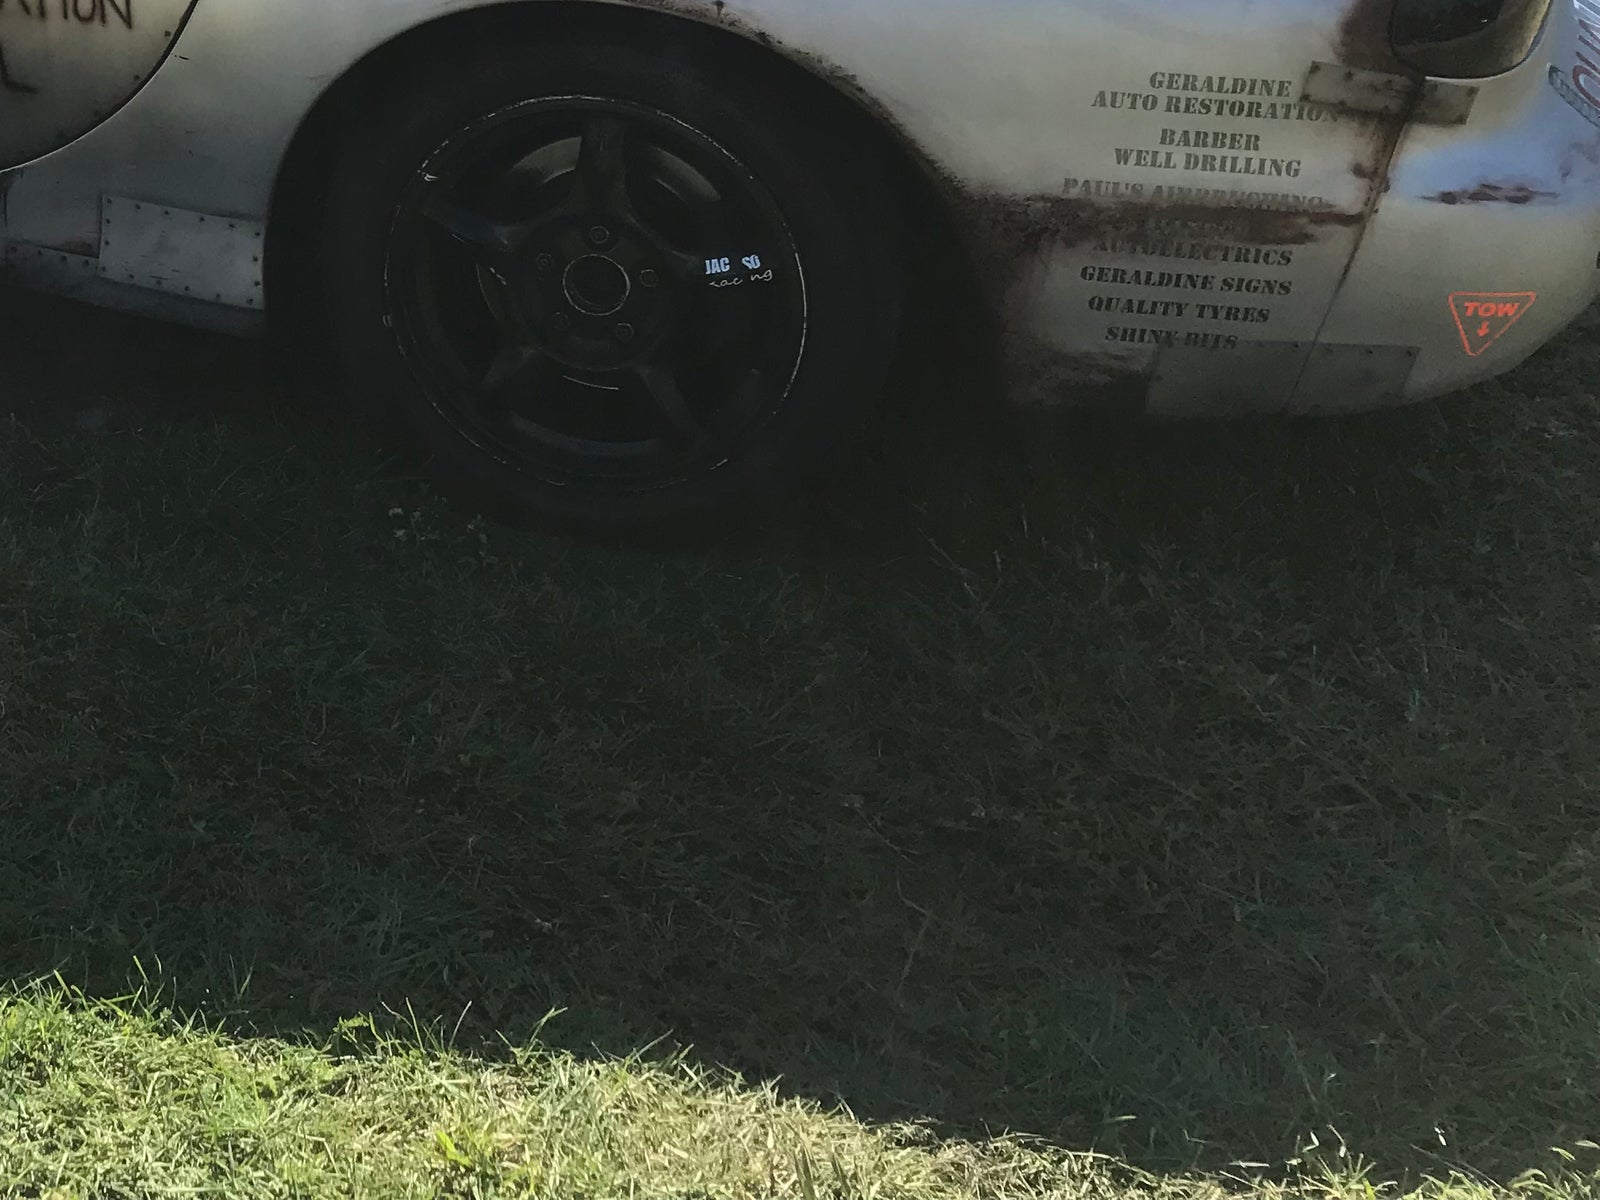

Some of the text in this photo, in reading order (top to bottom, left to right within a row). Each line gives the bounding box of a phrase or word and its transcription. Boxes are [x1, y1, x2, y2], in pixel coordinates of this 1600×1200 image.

[1149, 71, 1292, 98] GERALDINE
[1090, 89, 1158, 112] AUTO
[1159, 127, 1262, 151] BARBER
[1114, 147, 1302, 178] WELL DRILLING
[1080, 265, 1292, 296] GERALDINE SIGNS
[1088, 295, 1271, 323] QUALITY TYRES
[1464, 302, 1520, 317] TOW
[1104, 326, 1239, 351] SHINY BITS
